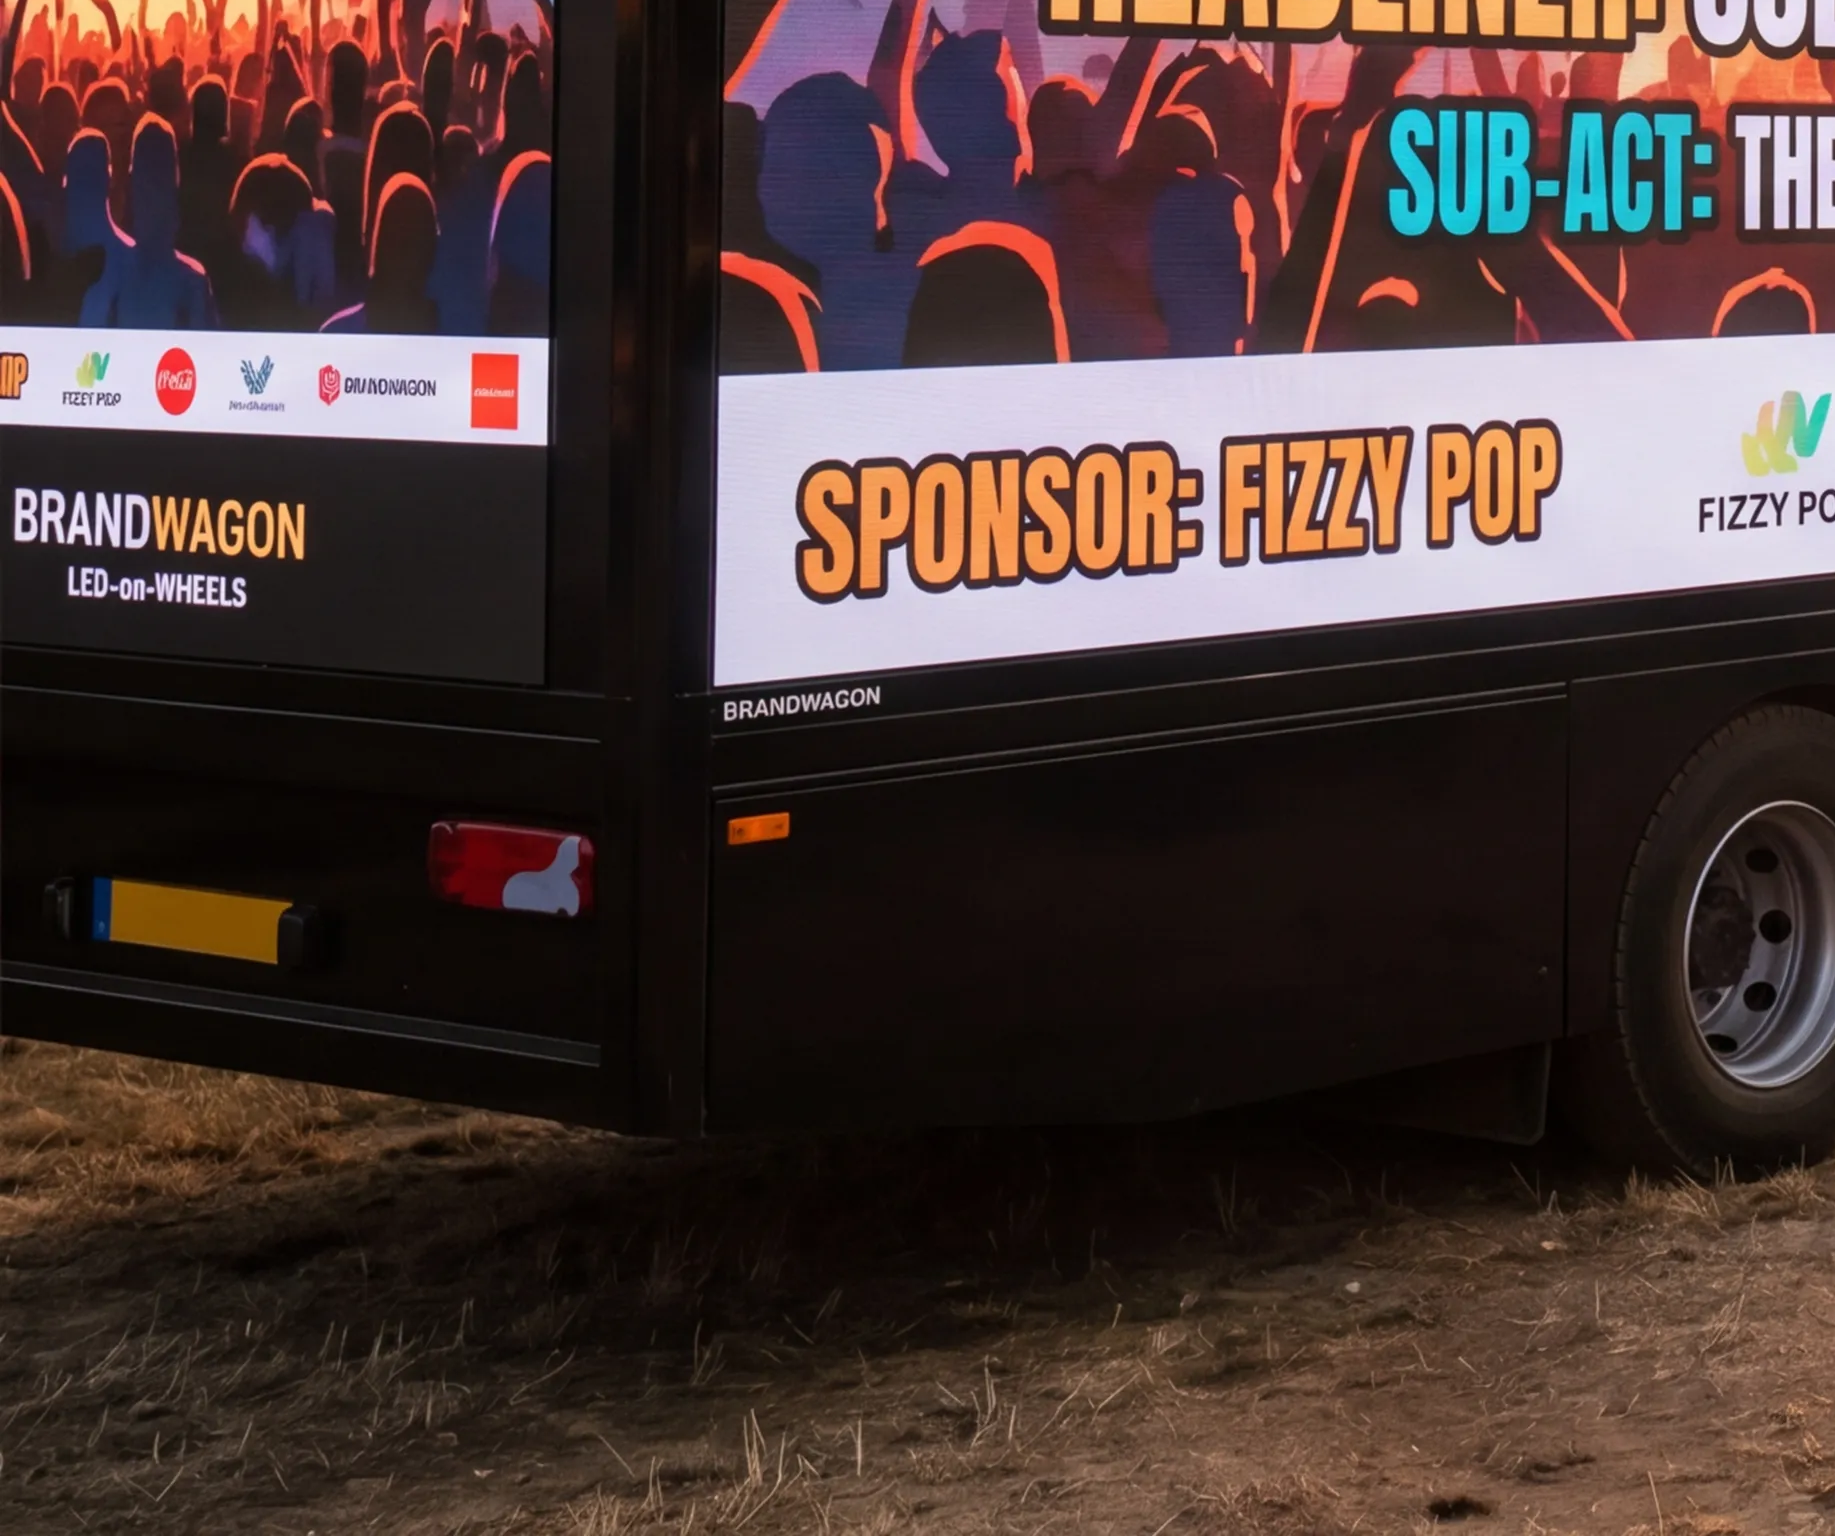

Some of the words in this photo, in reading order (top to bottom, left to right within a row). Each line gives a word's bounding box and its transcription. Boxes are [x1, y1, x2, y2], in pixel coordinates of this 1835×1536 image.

[1388, 107, 1713, 236] SUB-ACT:
[13, 487, 307, 561] BRANDWAGON
[801, 449, 1198, 597] SPONSOR:
[1223, 433, 1409, 561] FIZZY
[1430, 425, 1560, 543] POP
[1698, 490, 1790, 533] FIZZY
[67, 566, 248, 609] LED-on-WHEELS
[722, 685, 883, 724] BRANDWAGON
